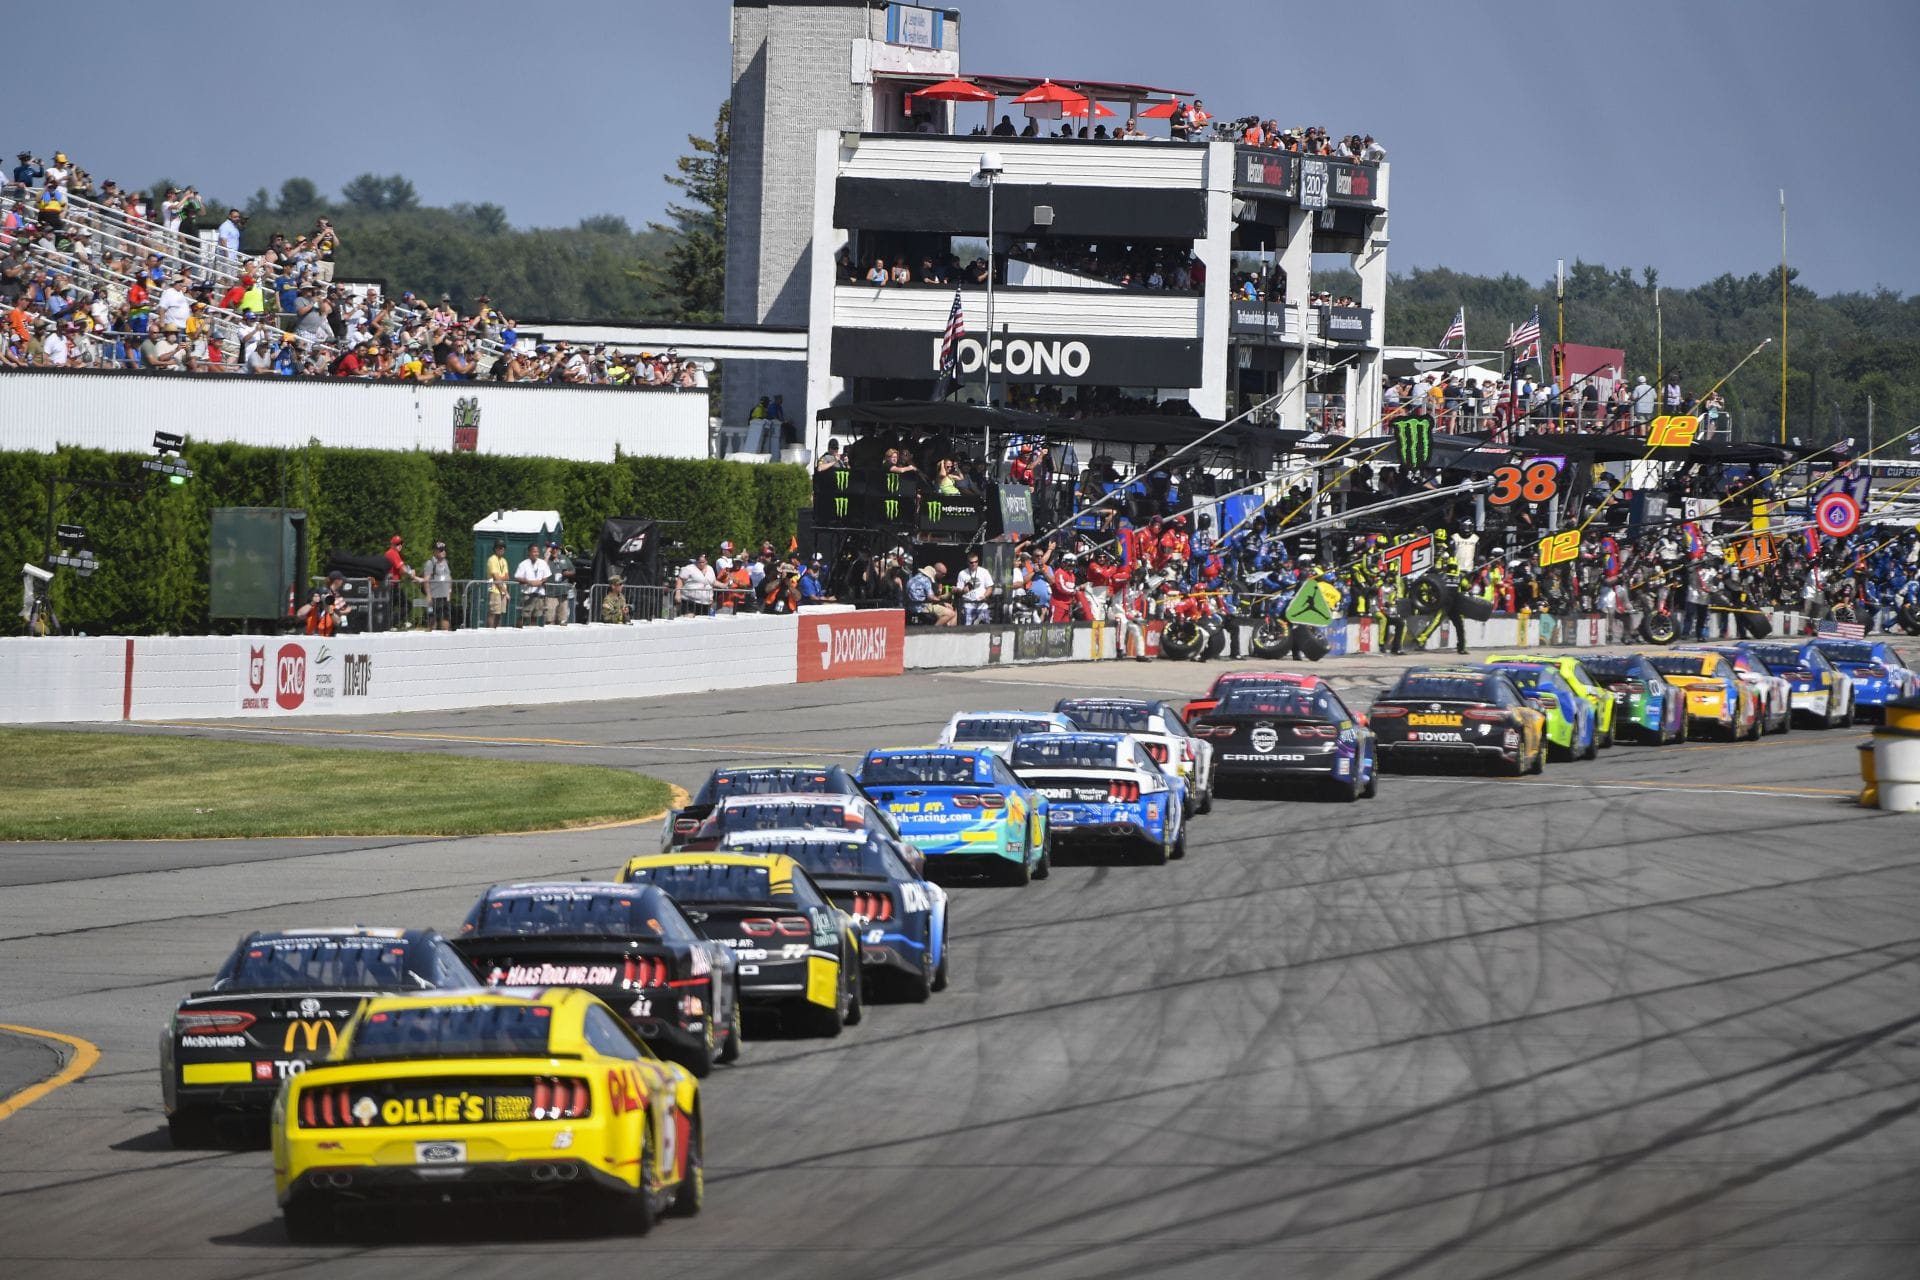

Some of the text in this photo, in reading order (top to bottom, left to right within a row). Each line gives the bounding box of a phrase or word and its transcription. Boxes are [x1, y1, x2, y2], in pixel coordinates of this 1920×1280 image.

[1306, 175, 1321, 195] 200
[1647, 416, 1699, 446] 12
[1887, 467, 1904, 477] CUP
[1488, 463, 1558, 505] 38
[1539, 530, 1581, 568] 12
[1740, 534, 1770, 566] 41
[834, 627, 887, 664] DOORDASH
[1418, 732, 1463, 742] TOYOTA
[1223, 753, 1305, 762] CAMARO
[889, 802, 920, 814] WIN
[782, 944, 809, 959] 77
[629, 1001, 652, 1017] 41
[181, 1035, 246, 1048] McDonald's
